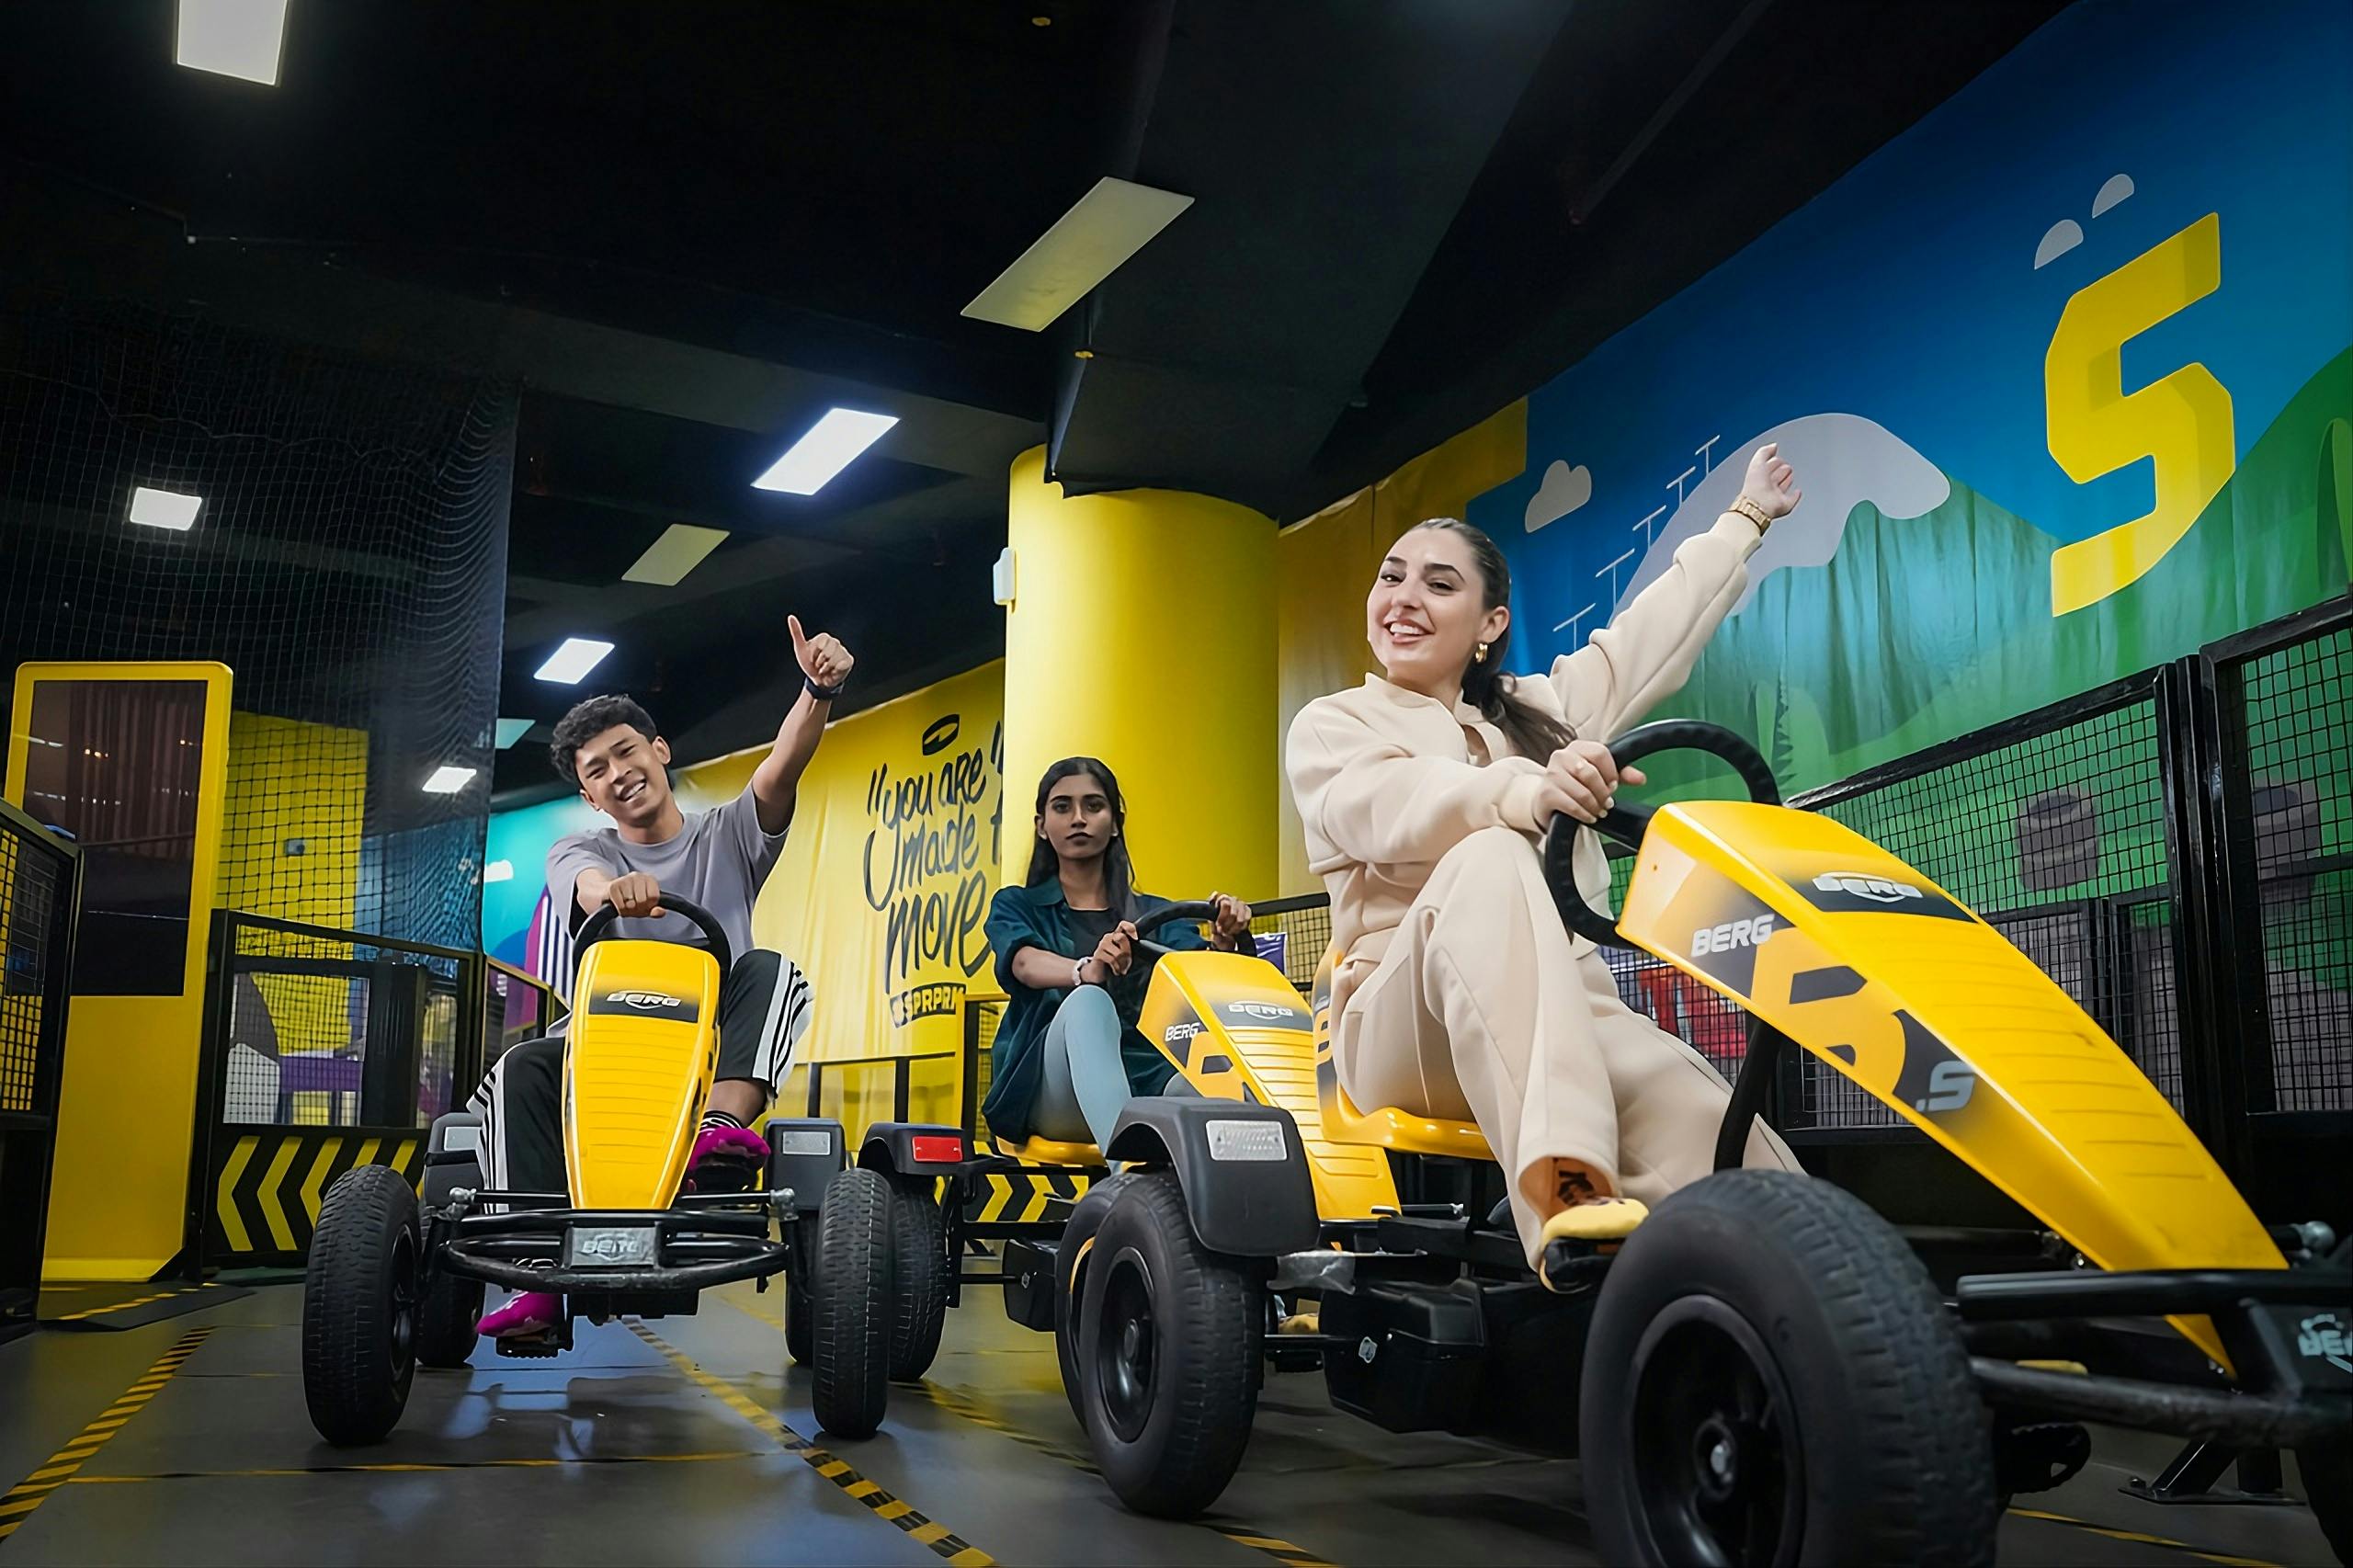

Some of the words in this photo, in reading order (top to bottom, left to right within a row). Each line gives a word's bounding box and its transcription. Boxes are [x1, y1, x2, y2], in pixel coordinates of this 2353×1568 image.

[938, 747, 987, 808] are
[899, 801, 979, 892] made
[885, 869, 991, 995] move
[1691, 913, 1775, 957] BERG
[1165, 1021, 1200, 1042] BERG
[2298, 1329, 2352, 1357] BE
